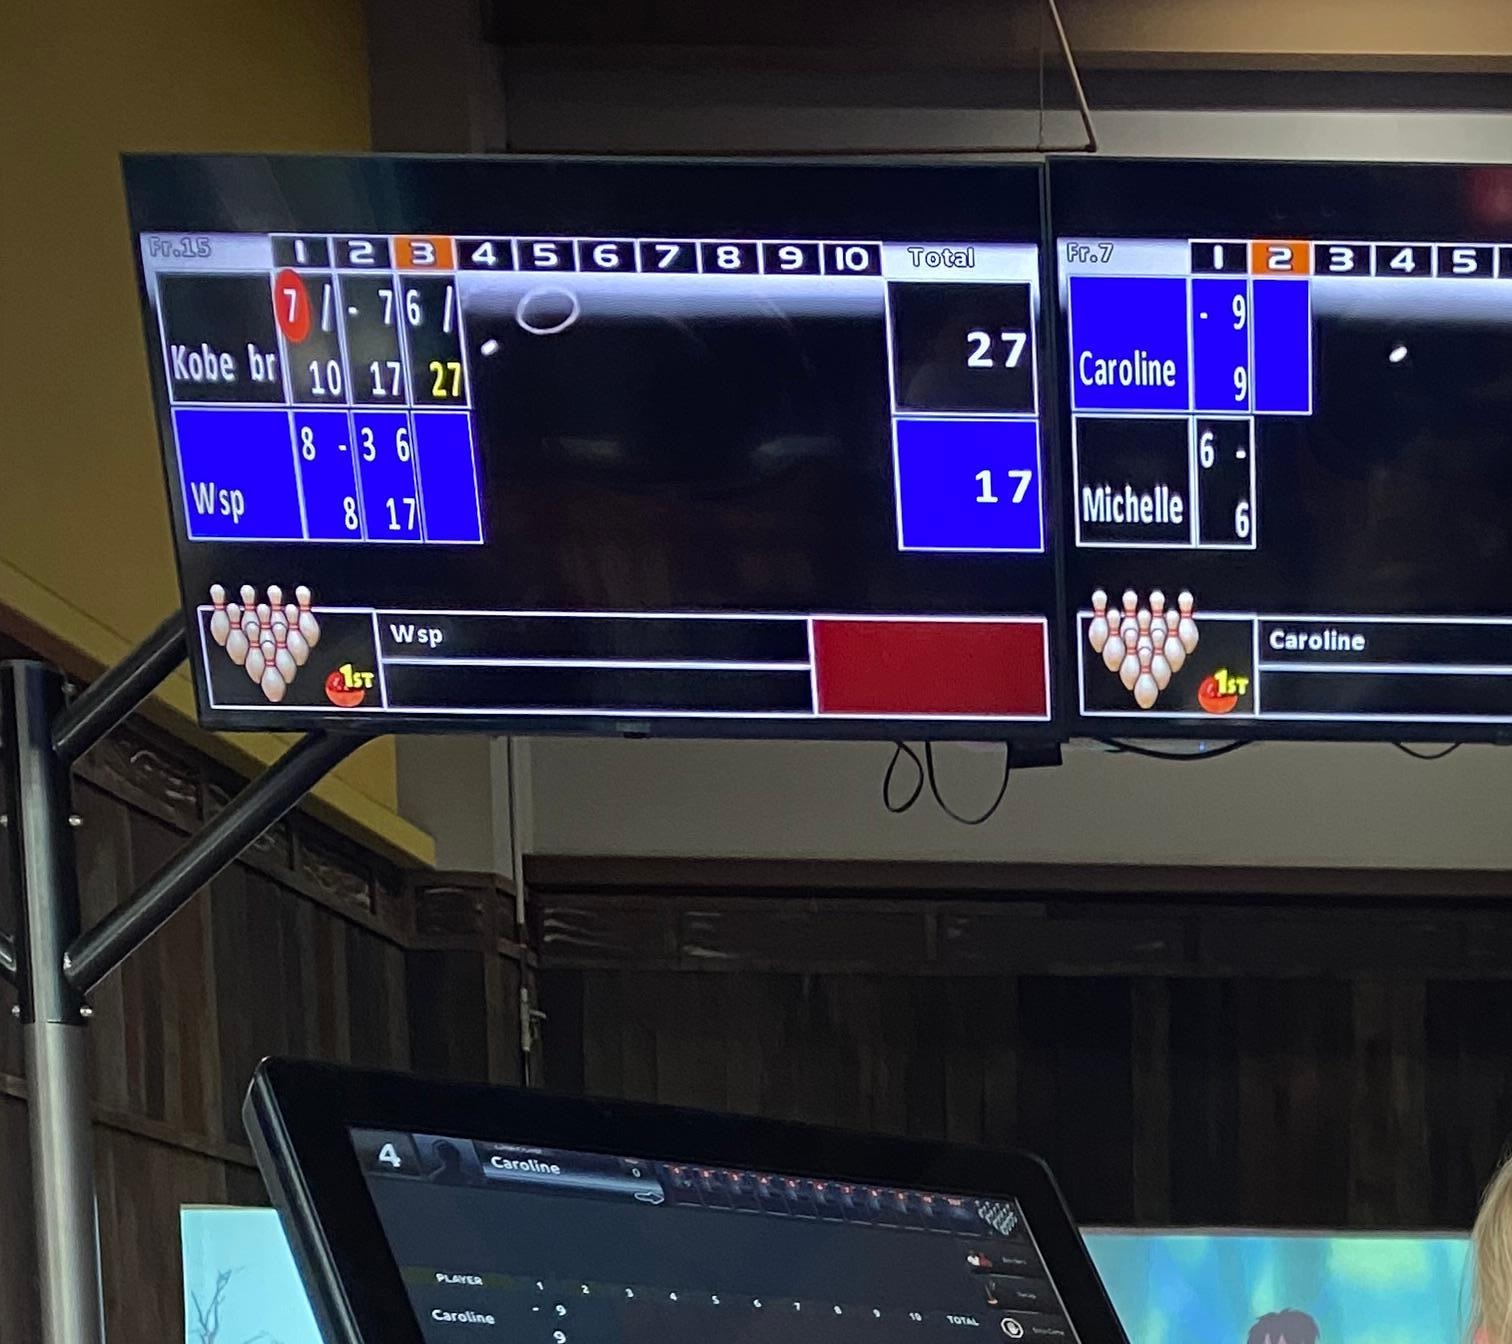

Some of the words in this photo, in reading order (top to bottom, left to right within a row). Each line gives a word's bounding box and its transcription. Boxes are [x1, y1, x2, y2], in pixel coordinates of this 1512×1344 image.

[149, 237, 212, 258] Fr.15
[295, 240, 305, 261] 1
[348, 241, 374, 263] 2
[409, 242, 435, 263] 3
[471, 242, 497, 265] 4
[533, 242, 559, 266] 5
[593, 244, 618, 268] 6
[656, 245, 680, 268] 7
[717, 245, 741, 269] 8
[778, 246, 803, 270] 9
[836, 246, 869, 271] 10
[908, 246, 976, 269] Total
[1067, 242, 1114, 263] Fr.7
[1213, 245, 1224, 269] 1
[1267, 246, 1294, 269] 2
[1329, 246, 1355, 271] 3
[1389, 248, 1416, 272] 4
[1451, 249, 1478, 273] 5
[282, 288, 297, 322] 7
[378, 290, 392, 324] 7
[406, 290, 421, 325] 6
[1232, 294, 1246, 330] 9
[172, 344, 235, 381] Kobe
[249, 344, 277, 381] br
[309, 360, 342, 395] 10
[370, 361, 401, 396] 17
[430, 361, 462, 397] 27
[967, 331, 1027, 368] 27
[1079, 349, 1176, 387] Caroline
[1233, 367, 1247, 401] 9
[301, 427, 315, 460] 8
[361, 428, 376, 461] 3
[396, 428, 411, 461] 6
[1200, 432, 1214, 468] 6
[191, 482, 245, 522] Wsp
[344, 497, 358, 529] 8
[386, 498, 416, 530] 17
[974, 470, 1033, 504] 17
[1082, 485, 1183, 524] Michelle
[1235, 502, 1250, 538] 6
[390, 624, 443, 647] Wsp
[1269, 630, 1365, 651] Caroline
[379, 1143, 401, 1168] 4
[491, 1156, 561, 1175] Caroline
[436, 1273, 483, 1285] PLAYER
[581, 1284, 590, 1294] 2
[670, 1292, 678, 1301] 4
[712, 1295, 720, 1305] 5
[947, 1315, 979, 1326] TOTAL
[556, 1304, 566, 1316] 9
[432, 1308, 495, 1324] Caroline
[553, 1330, 566, 1344] 9
